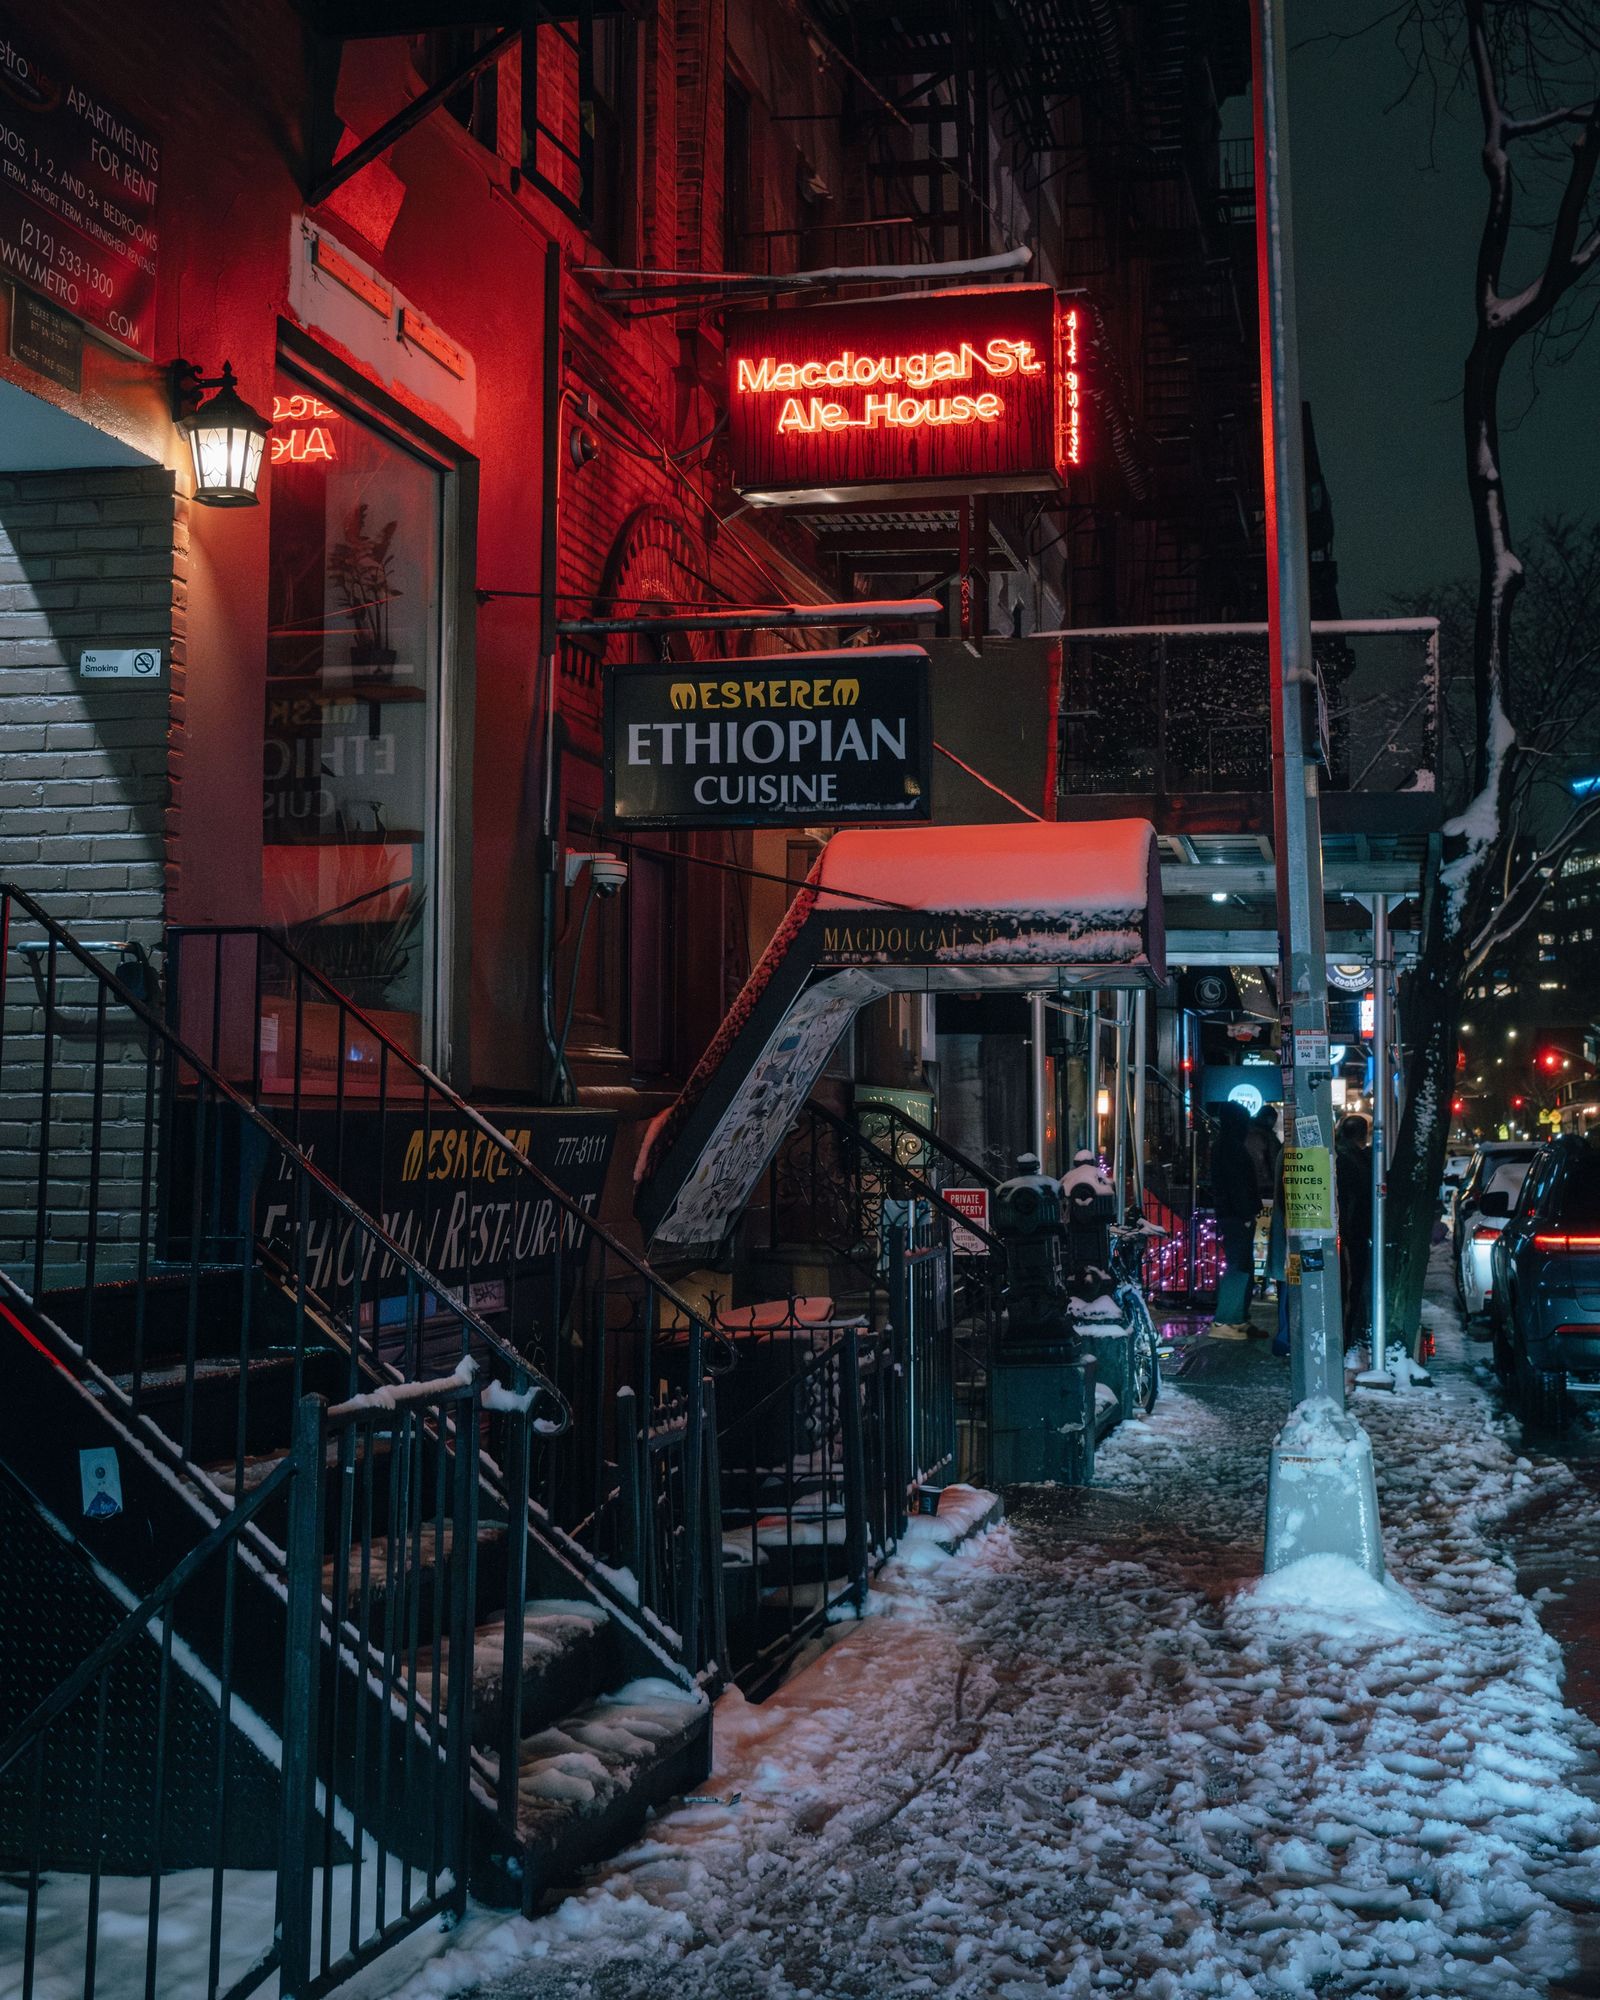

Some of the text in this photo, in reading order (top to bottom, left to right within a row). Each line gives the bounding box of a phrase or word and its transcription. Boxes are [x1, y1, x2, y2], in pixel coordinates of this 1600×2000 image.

[66, 83, 159, 172] APARTMENTS
[91, 137, 159, 206] FOR RENT
[31, 179, 60, 209] SHORT
[86, 217, 126, 256] FURNISHED
[60, 170, 86, 201] AND
[87, 188, 100, 209] 3+
[103, 200, 158, 252] BEDROOMS
[20, 217, 113, 299] (212) 533-1300
[737, 342, 974, 394] Macdougal
[776, 391, 1006, 434] Ale House
[84, 664, 119, 674] Smoking
[85, 655, 97, 663] No
[668, 677, 862, 711] MESKEREM
[626, 716, 907, 767] ETHIOPIAN
[693, 773, 838, 807] CUISINE
[554, 1134, 608, 1168] 777-8111
[950, 1194, 980, 1204] PRIVATE
